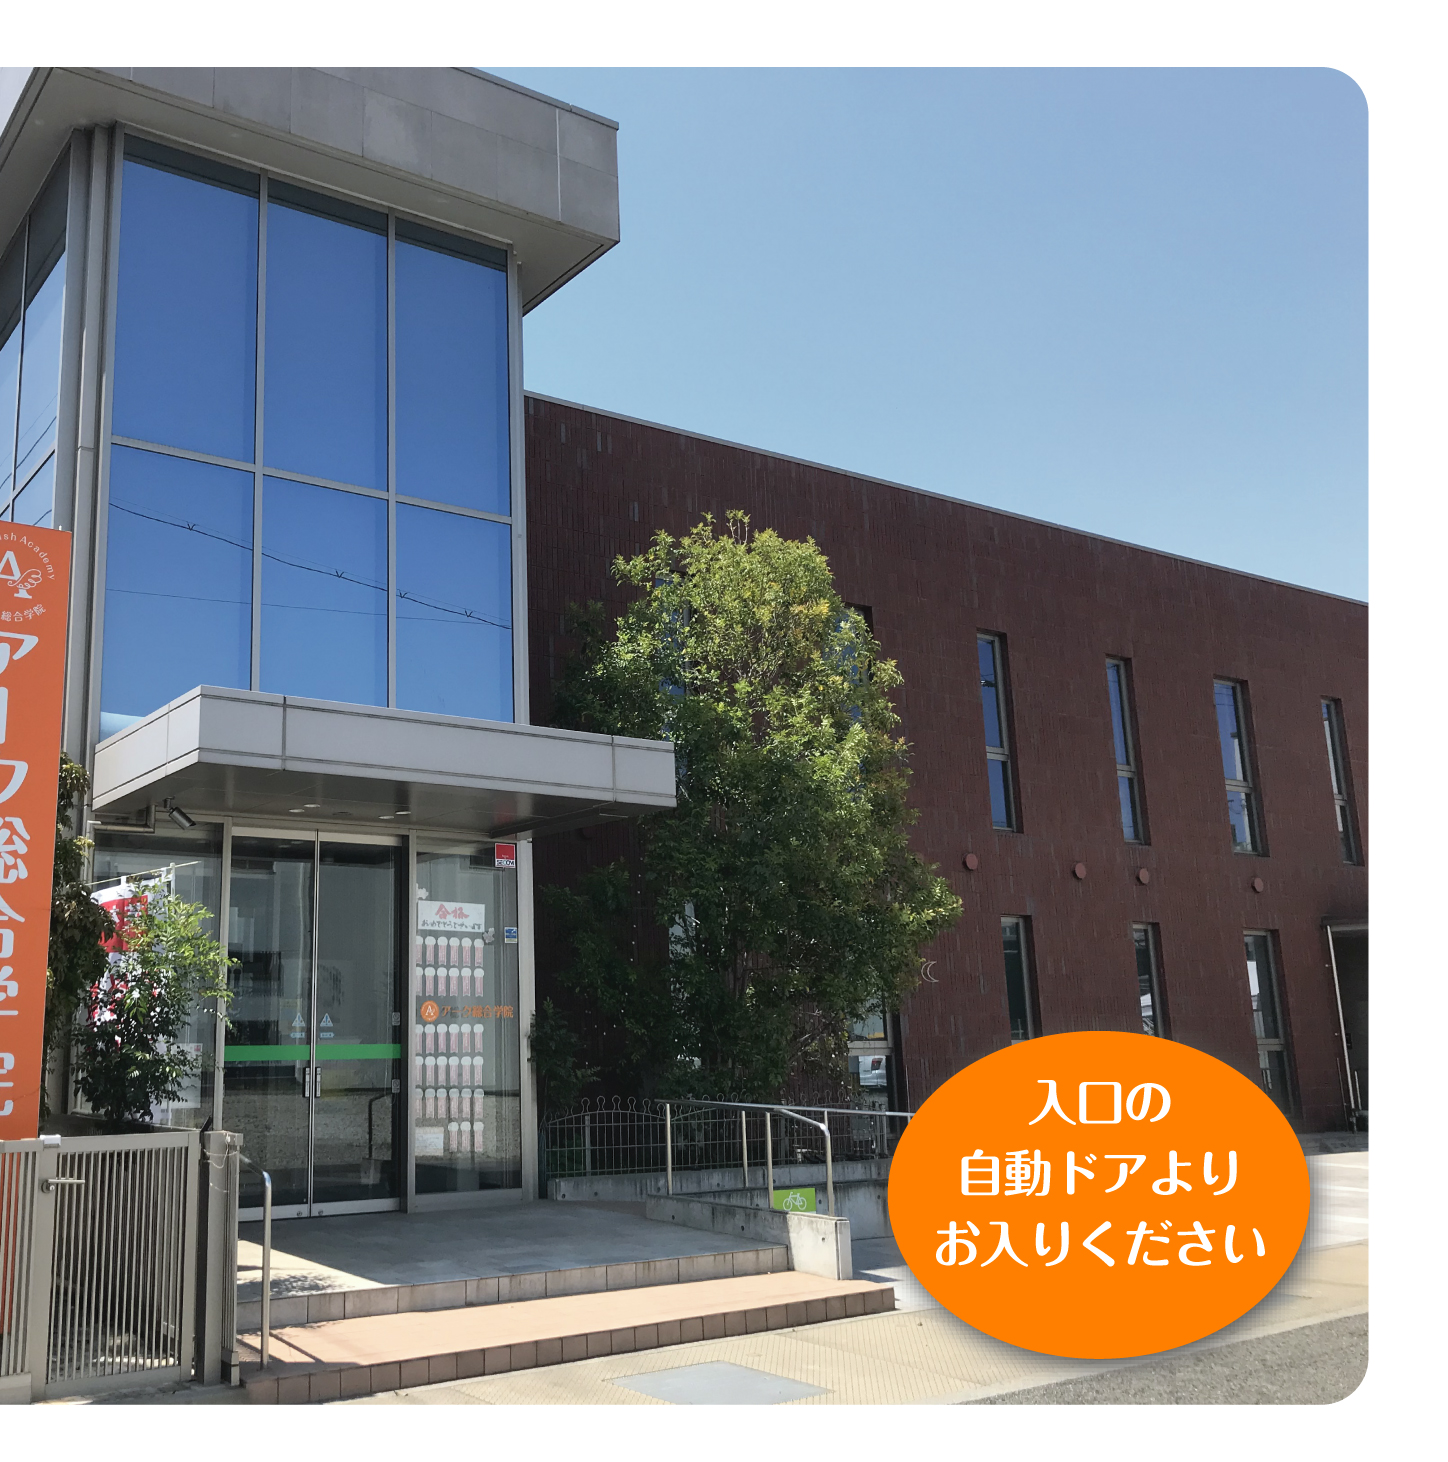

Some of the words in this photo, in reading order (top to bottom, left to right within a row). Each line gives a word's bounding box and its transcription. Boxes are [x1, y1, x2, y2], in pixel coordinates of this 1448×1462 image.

[20, 535, 55, 580] Academy
[435, 903, 470, 920] 合格
[441, 1005, 514, 1018] アーク総合学院
